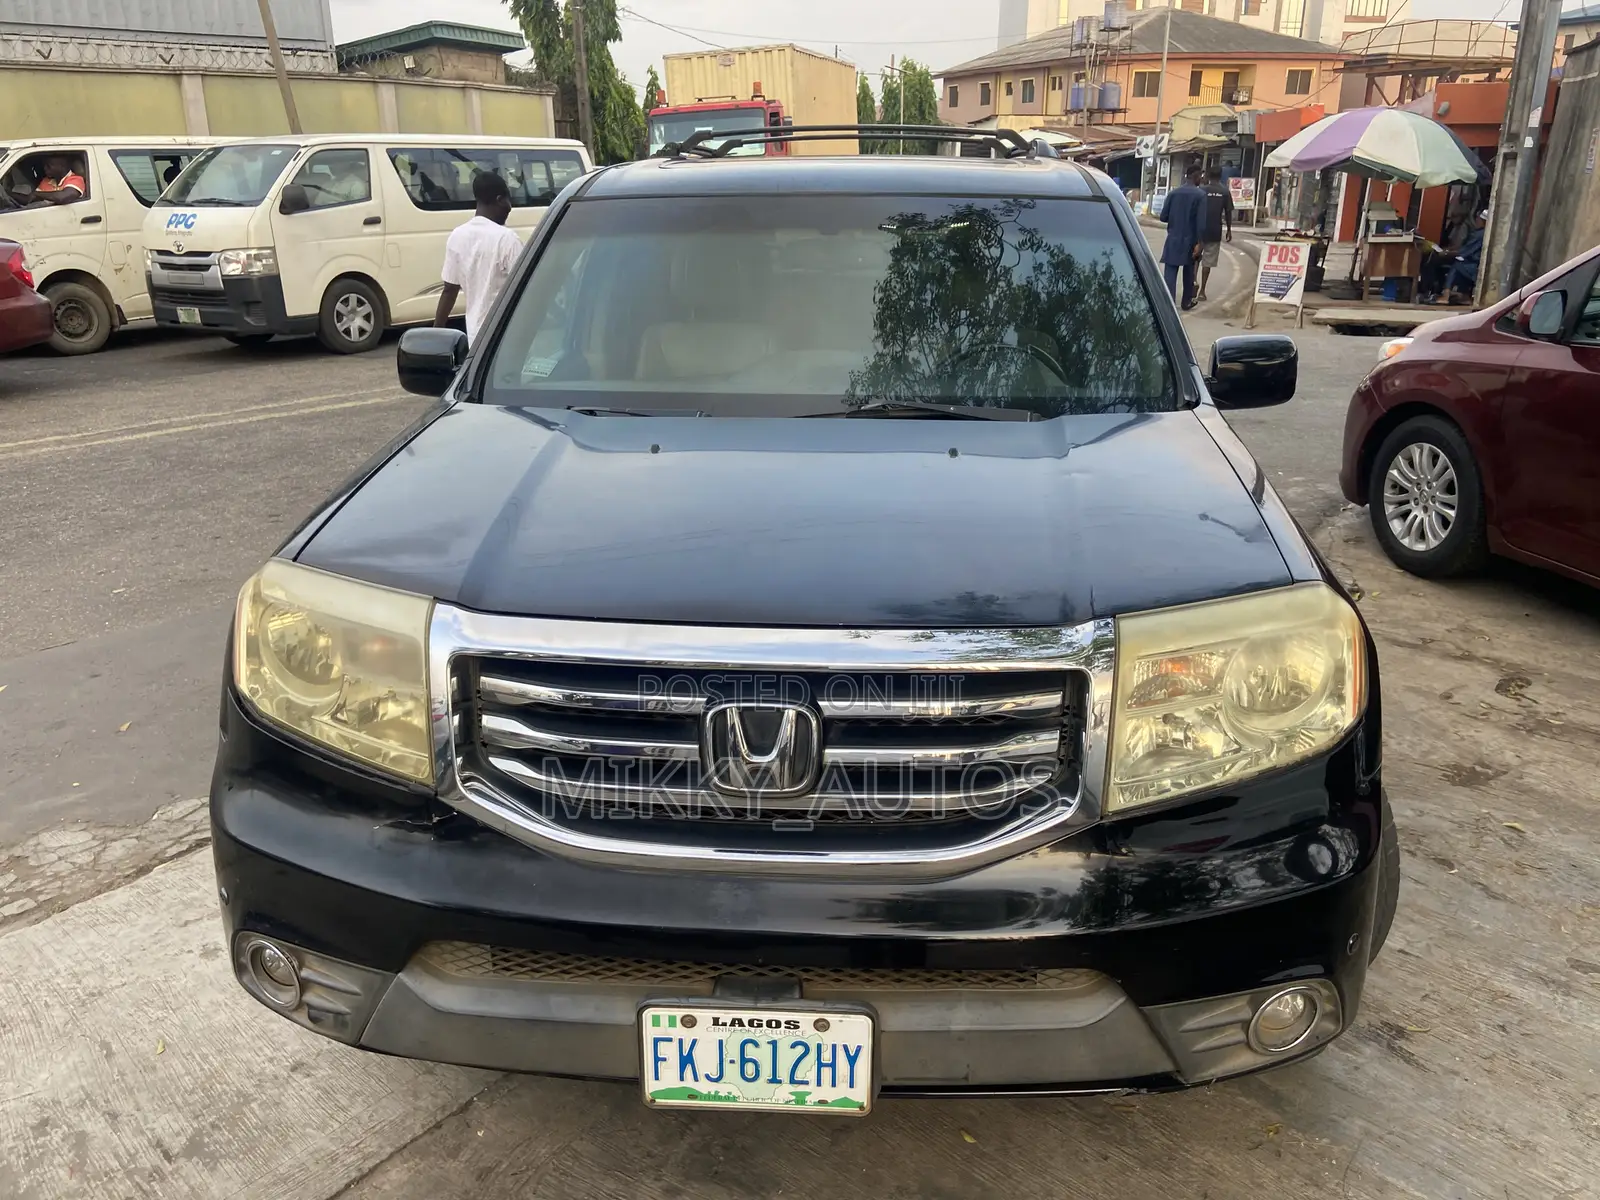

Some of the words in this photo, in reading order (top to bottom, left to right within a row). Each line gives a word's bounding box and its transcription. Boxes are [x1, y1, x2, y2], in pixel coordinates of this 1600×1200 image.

[167, 213, 197, 229] PPC
[1267, 245, 1300, 264] POS
[712, 1017, 800, 1030] LAGOS
[752, 1028, 806, 1036] EXCELLENCE
[653, 1037, 862, 1089] FKJ-612HY
